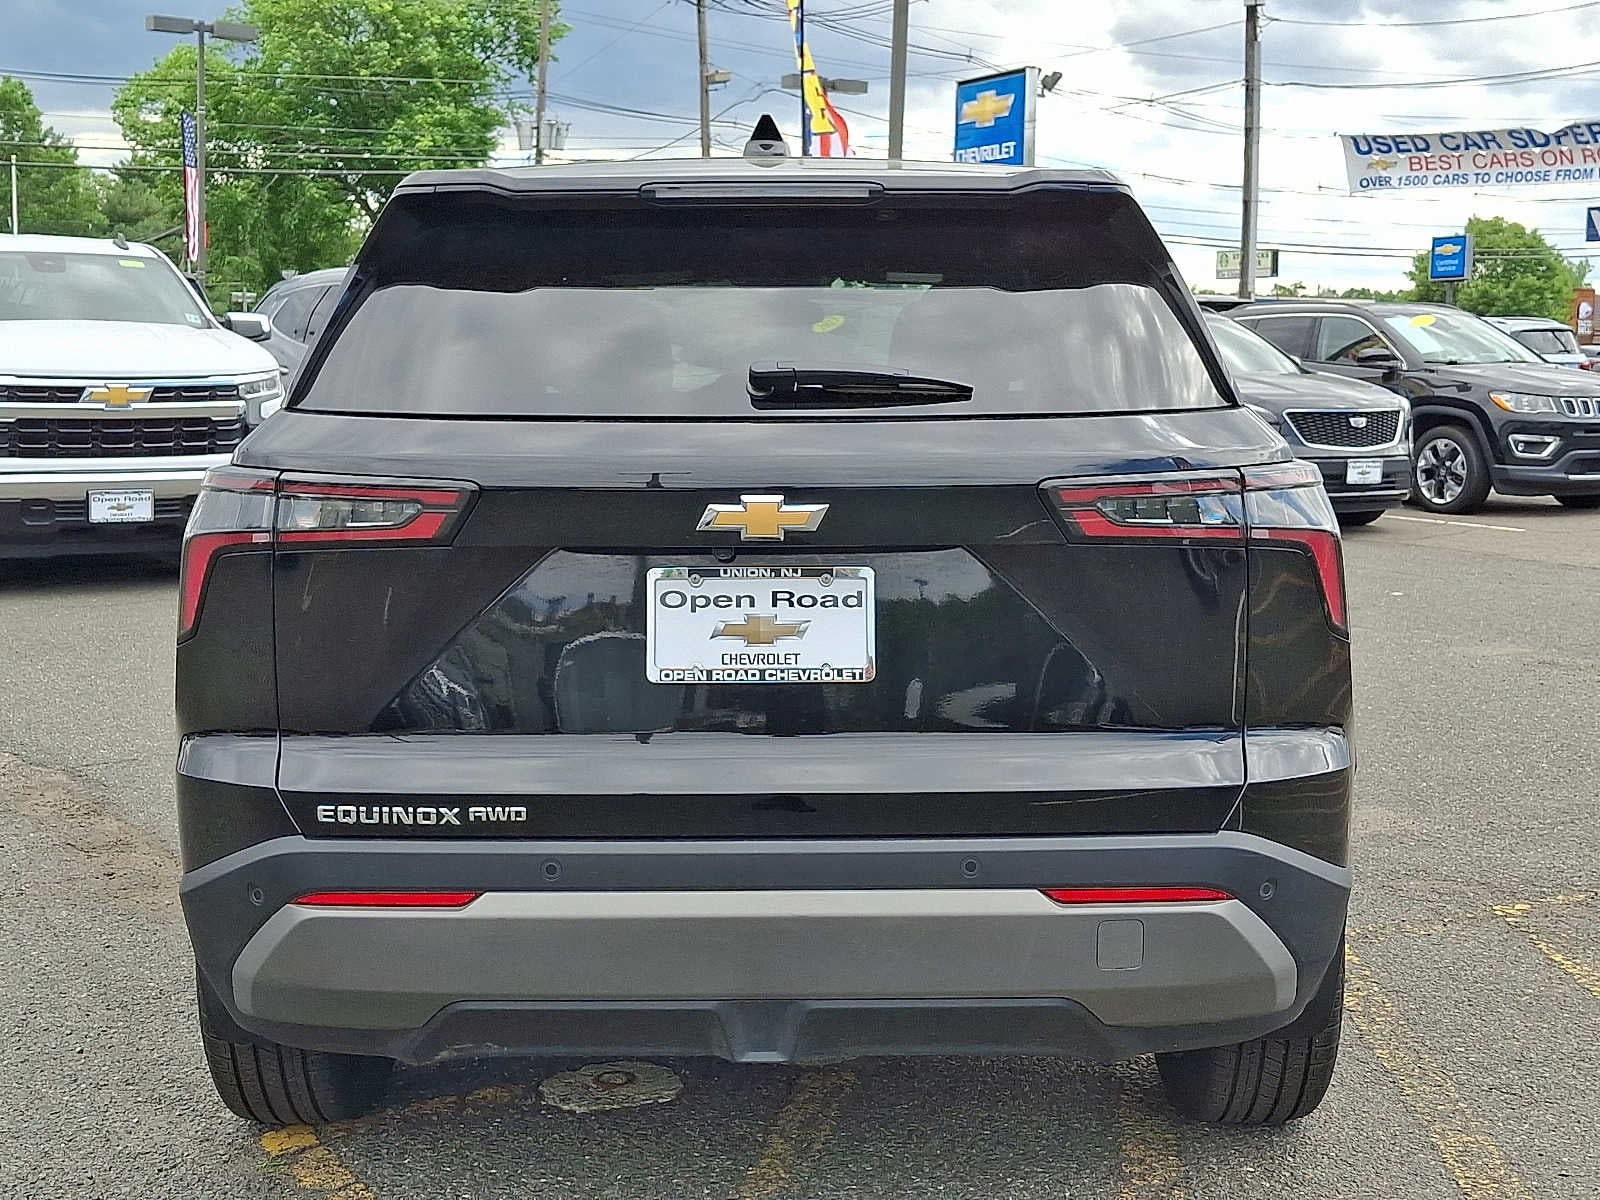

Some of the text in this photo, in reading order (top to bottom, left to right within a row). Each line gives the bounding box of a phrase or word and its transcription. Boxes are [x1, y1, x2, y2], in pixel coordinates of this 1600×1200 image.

[955, 141, 1016, 162] CHEVROLET
[1350, 134, 1432, 155] USED
[1440, 131, 1503, 151] CAR
[1409, 154, 1464, 172] BEST
[1472, 151, 1534, 169] CARS
[1541, 148, 1574, 166] ON
[1360, 175, 1392, 188] OVER
[1397, 174, 1428, 186] 1500
[1433, 172, 1470, 185] CARS
[1474, 172, 1491, 184] TO
[1495, 170, 1552, 183] CHOOSE
[1555, 168, 1594, 181] FROM
[719, 567, 802, 579] UNION, NJ
[659, 590, 863, 613] Open Road
[721, 653, 801, 666] CHEVROLET
[660, 668, 863, 681] OPEN ROAD CHEVROLET
[316, 804, 527, 825] EQUINOX AWD
